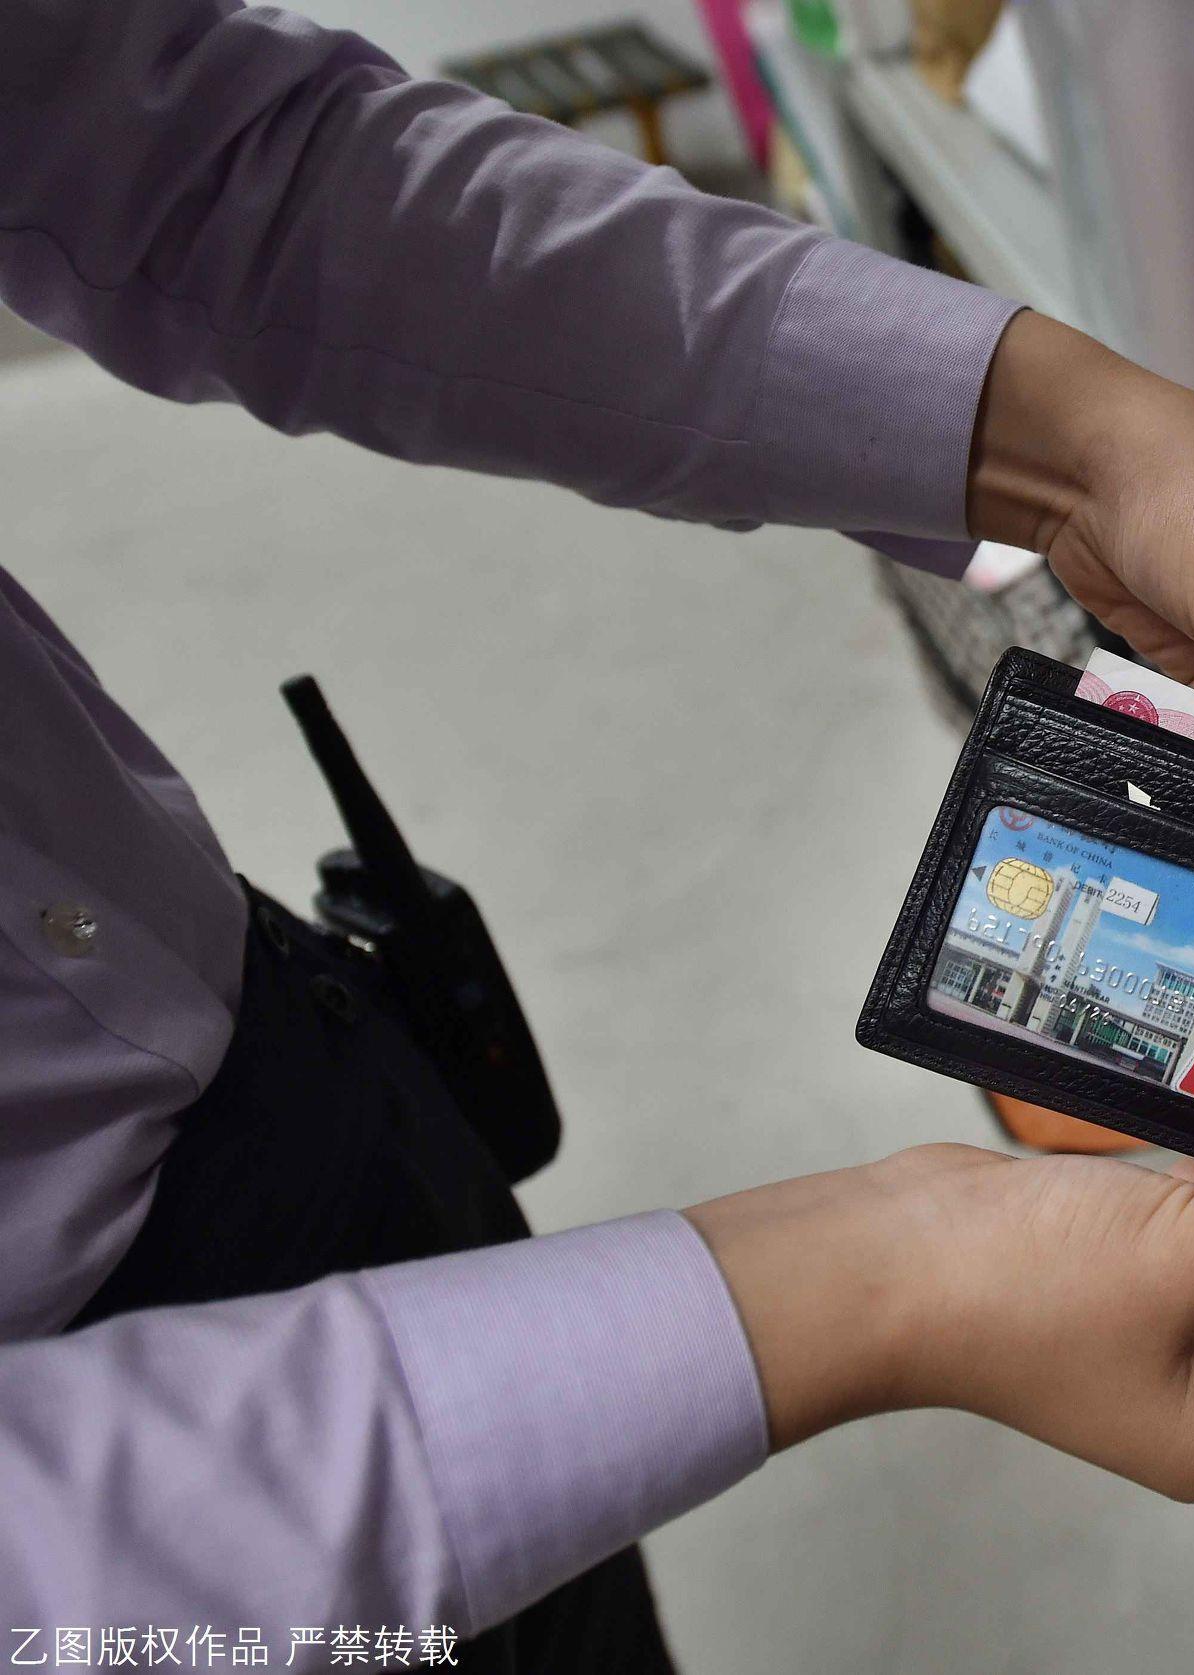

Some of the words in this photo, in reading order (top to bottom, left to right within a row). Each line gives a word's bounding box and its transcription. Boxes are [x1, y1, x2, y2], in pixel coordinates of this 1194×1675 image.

[1037, 832, 1065, 849] BANK
[1066, 844, 1079, 856] OF
[1080, 848, 1113, 869] CHINA
[1074, 880, 1104, 899] DEBIT
[1105, 888, 1142, 913] 2254
